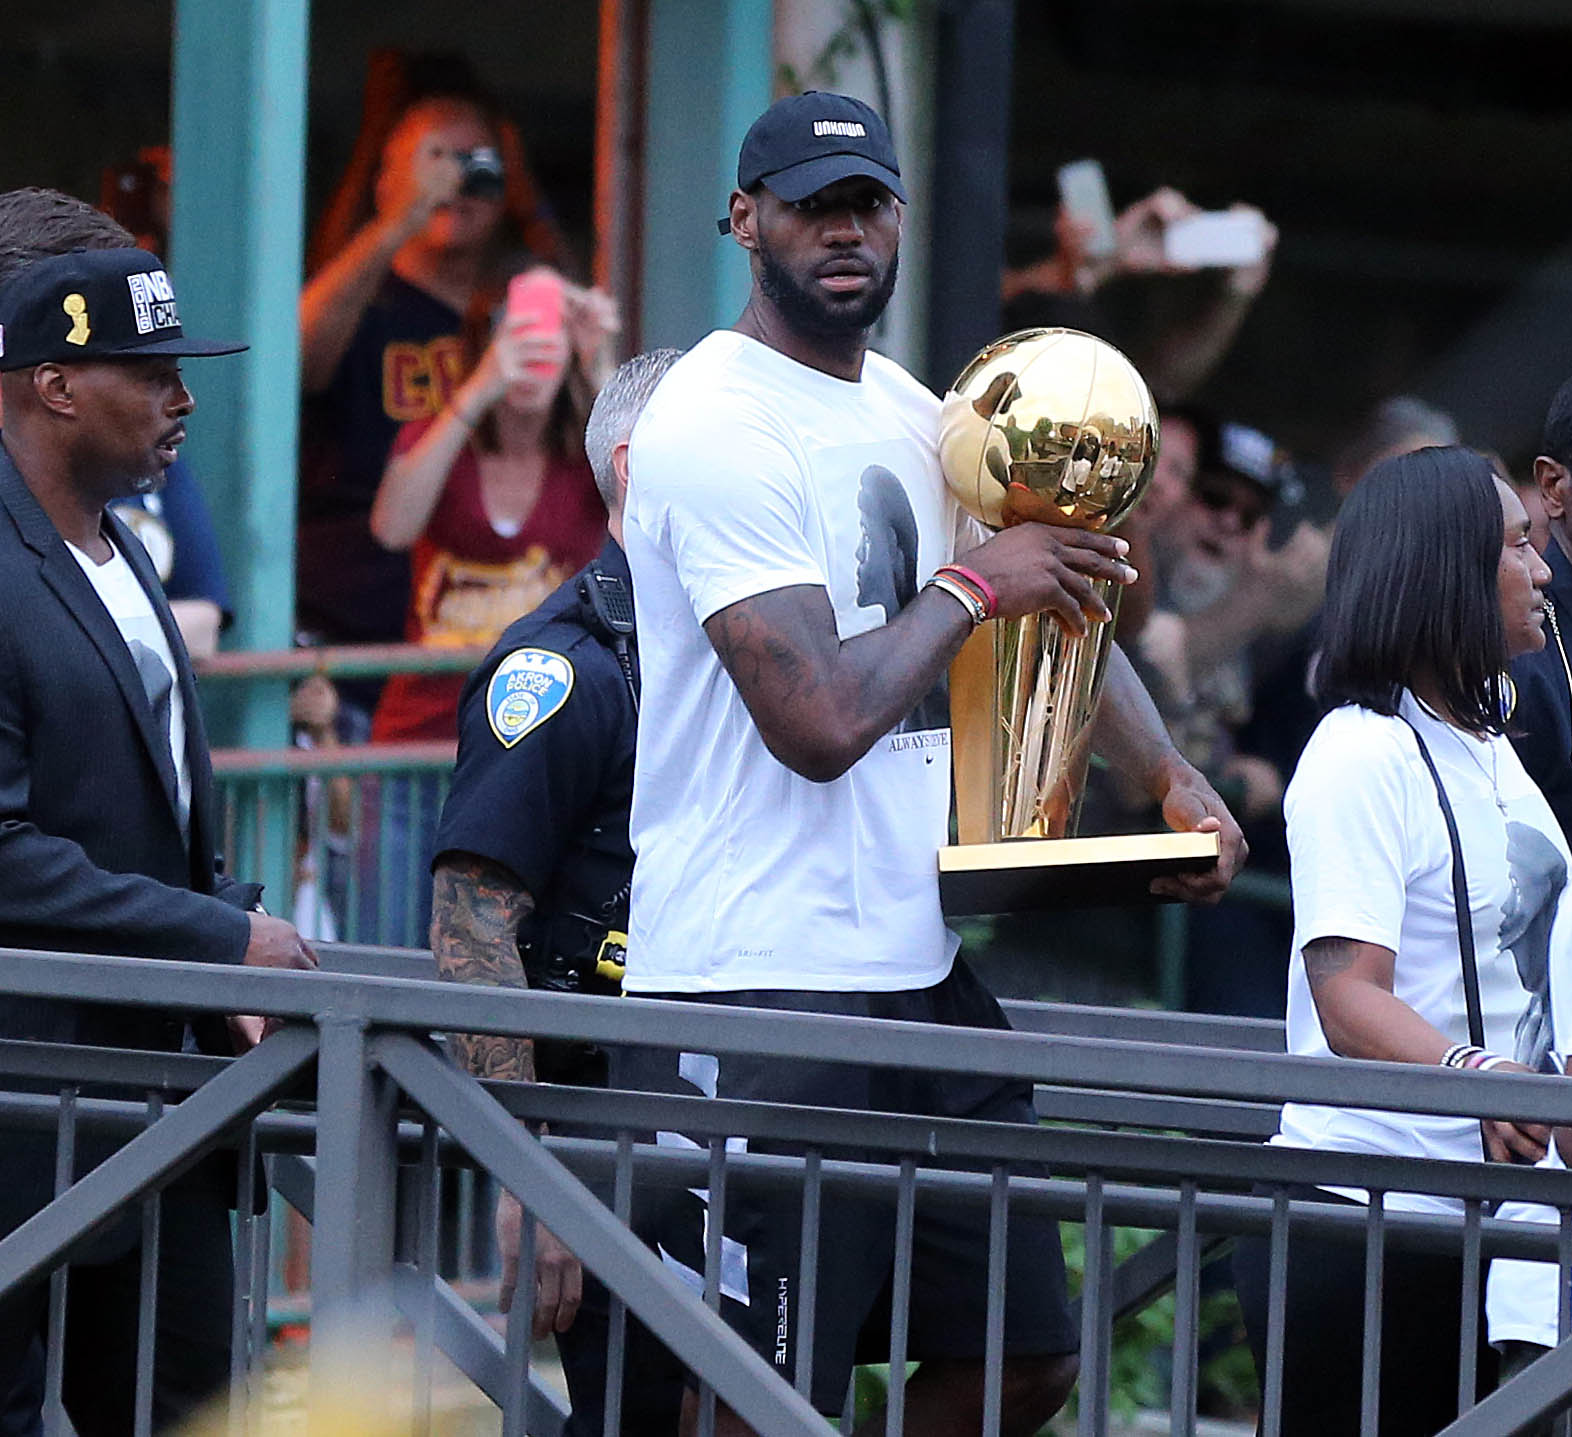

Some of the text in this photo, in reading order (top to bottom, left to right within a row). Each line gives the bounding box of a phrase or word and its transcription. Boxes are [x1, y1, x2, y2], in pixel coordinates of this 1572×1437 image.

[131, 277, 151, 330] 2016
[506, 680, 549, 697] POLICE
[508, 670, 554, 689] AKRON
